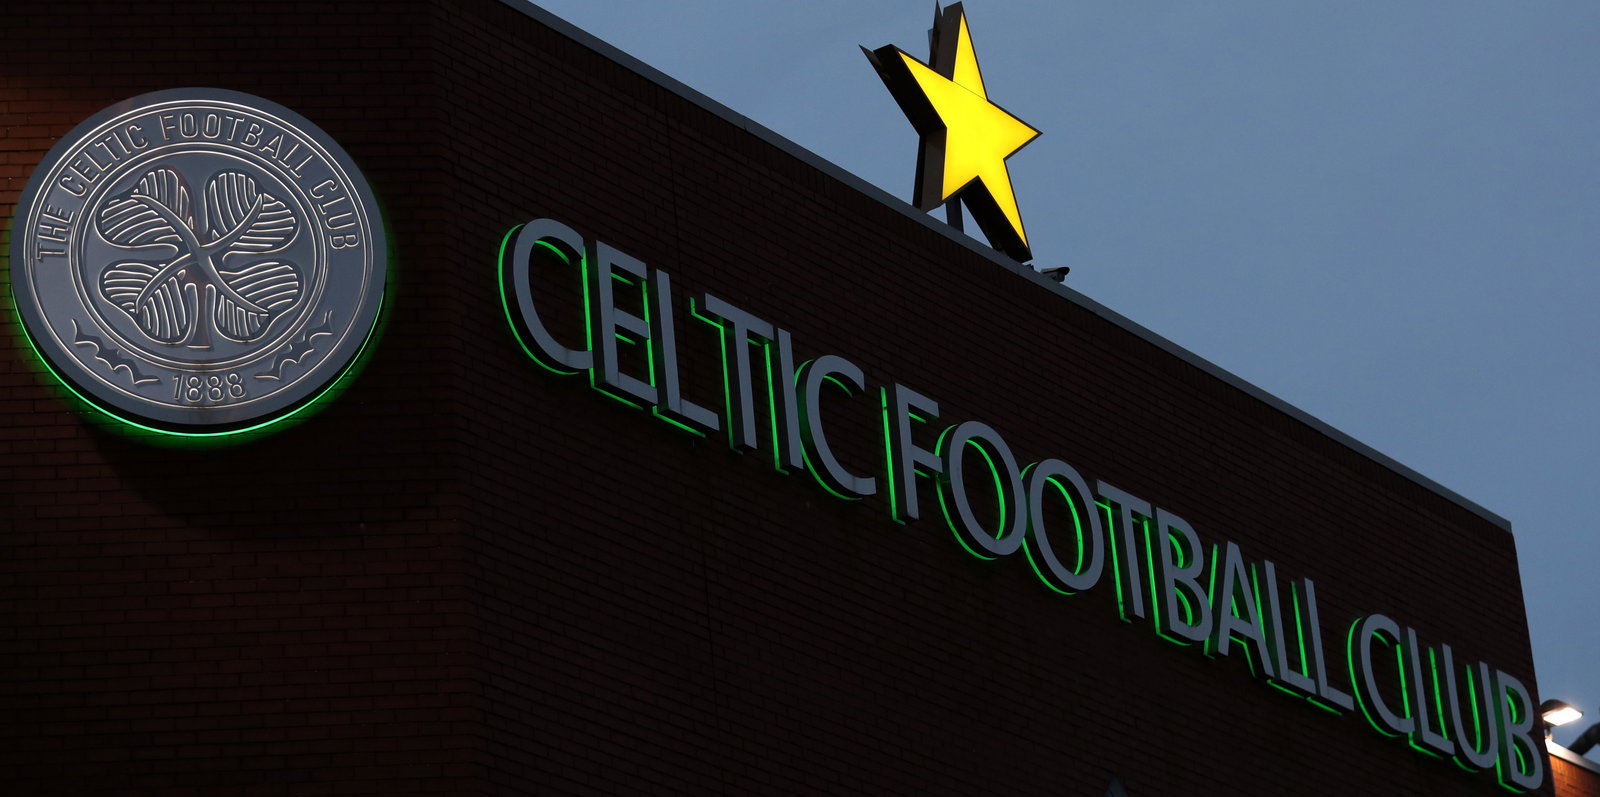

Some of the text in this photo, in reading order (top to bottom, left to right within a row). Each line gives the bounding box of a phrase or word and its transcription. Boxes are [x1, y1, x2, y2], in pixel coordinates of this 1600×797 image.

[35, 112, 359, 260] THE CELTIC FOOTBALL CLUB
[171, 372, 247, 402] 1888
[503, 218, 1544, 791] CELTIC FOOTBALL CLUB
